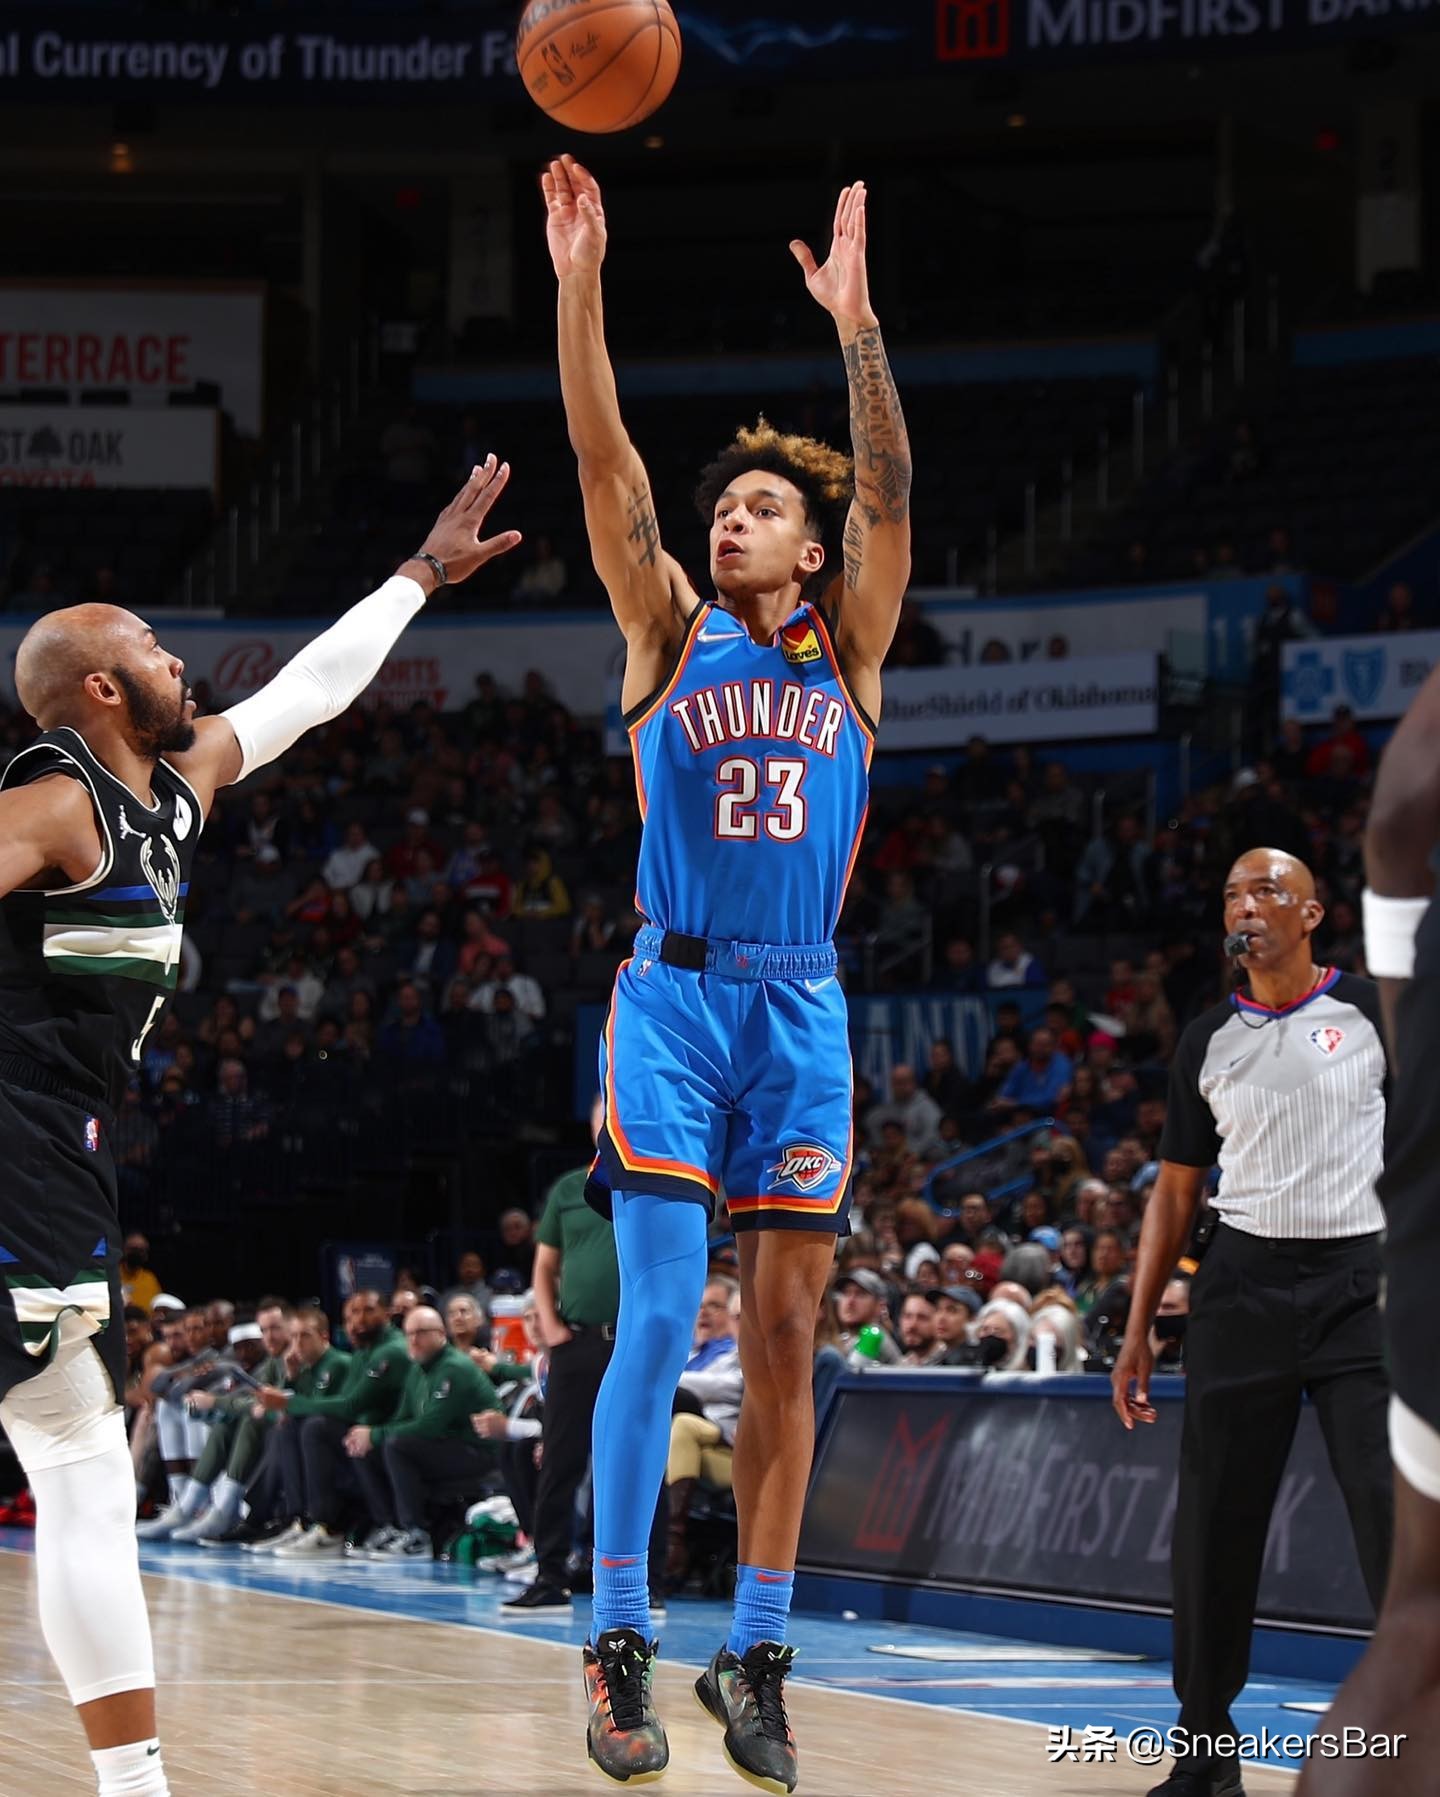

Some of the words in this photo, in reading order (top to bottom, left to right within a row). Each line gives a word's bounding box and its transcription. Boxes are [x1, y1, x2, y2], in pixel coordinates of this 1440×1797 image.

[32, 30, 229, 88] Currency
[240, 33, 285, 79] of
[296, 34, 472, 80] Thunder
[0, 332, 191, 384] TERRACE
[69, 430, 124, 467] OAK
[671, 678, 846, 757] THUNDER
[715, 755, 806, 842] 23
[779, 1156, 825, 1178] OKC
